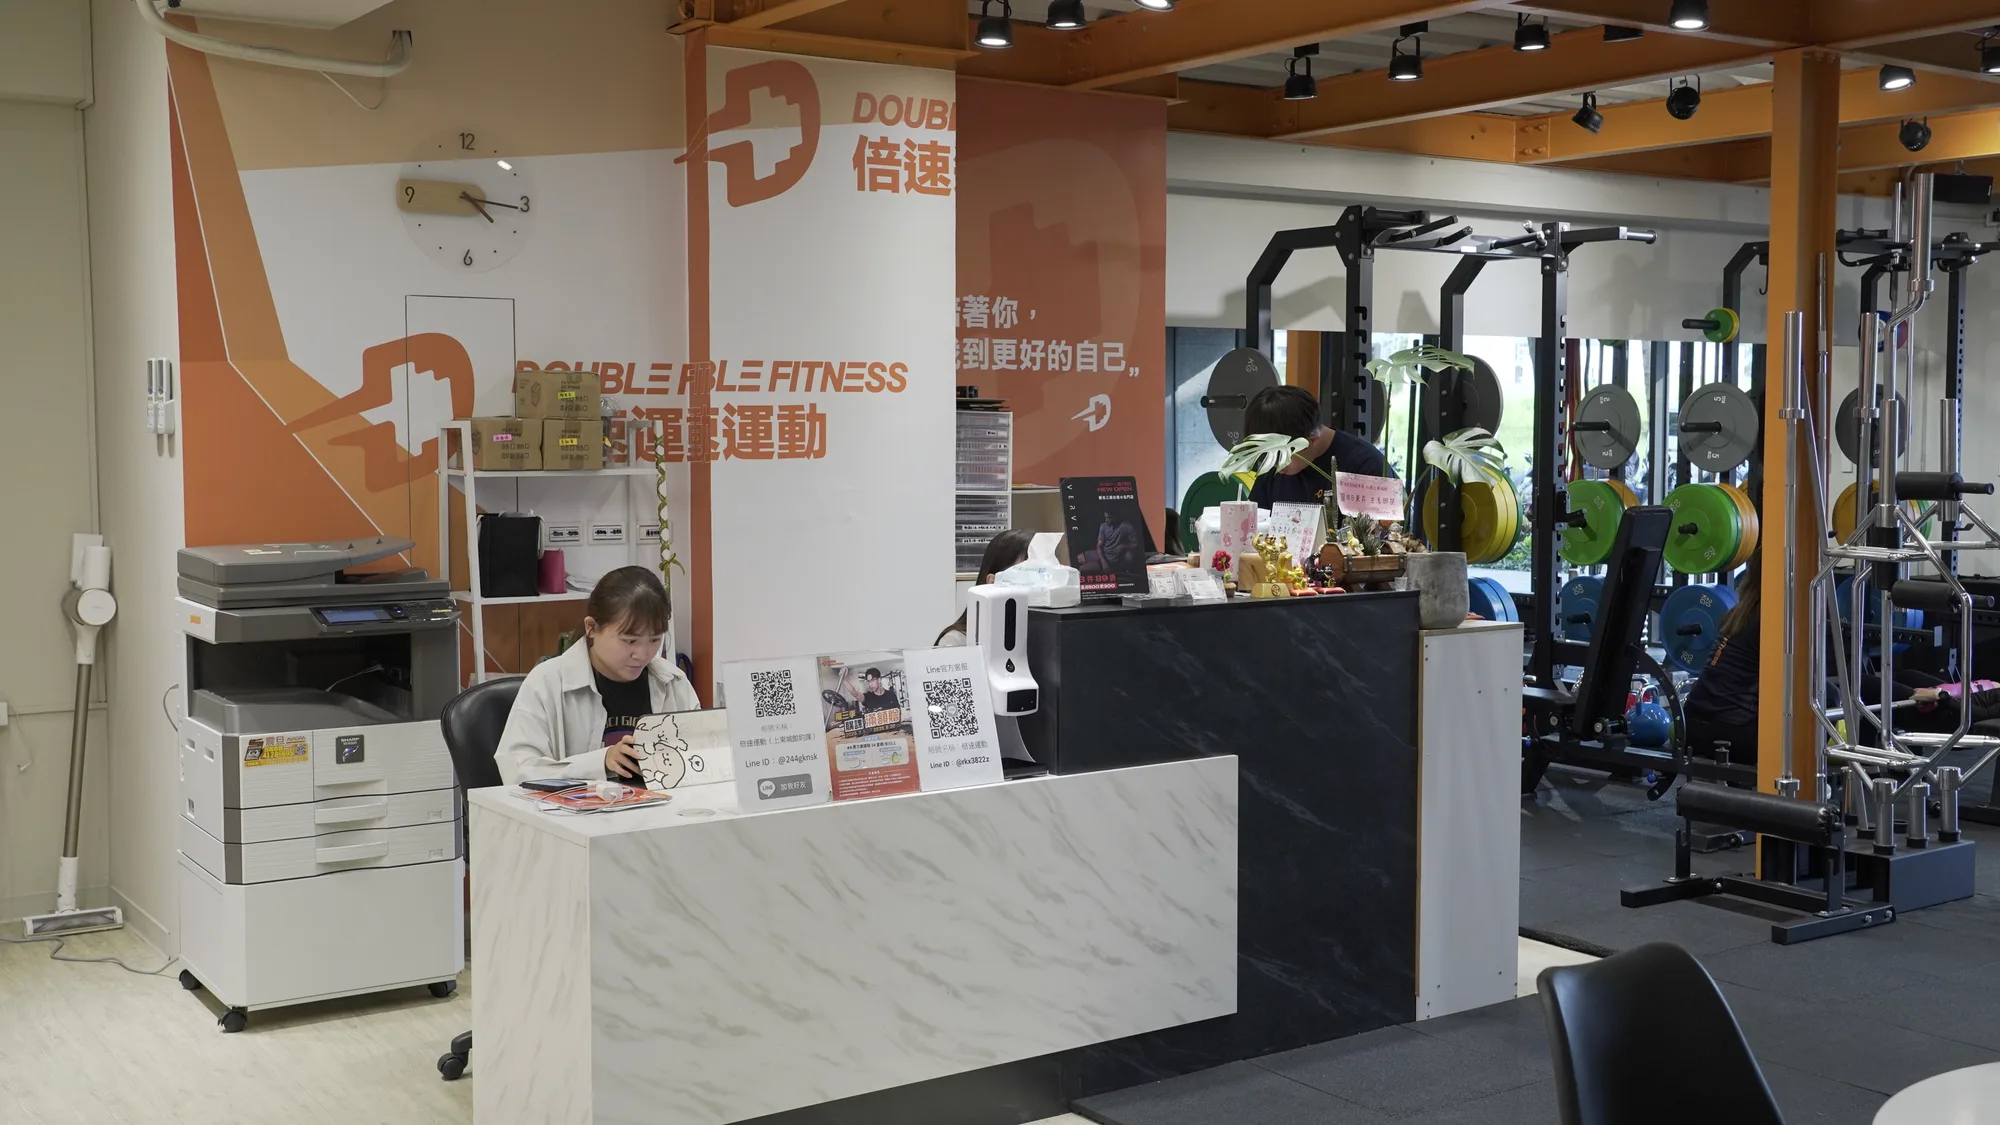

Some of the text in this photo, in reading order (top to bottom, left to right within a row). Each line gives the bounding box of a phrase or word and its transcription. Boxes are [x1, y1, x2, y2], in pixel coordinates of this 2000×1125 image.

[459, 132, 476, 150] 12
[852, 134, 957, 197] 倍速
[405, 186, 415, 204] 9
[520, 196, 530, 213] 3
[463, 249, 473, 266] 6
[956, 294, 1036, 329] 著你，
[768, 360, 909, 393] FITNESS
[1067, 484, 1078, 531] VERVE
[745, 760, 760, 768] Line
[930, 761, 943, 769] Line
